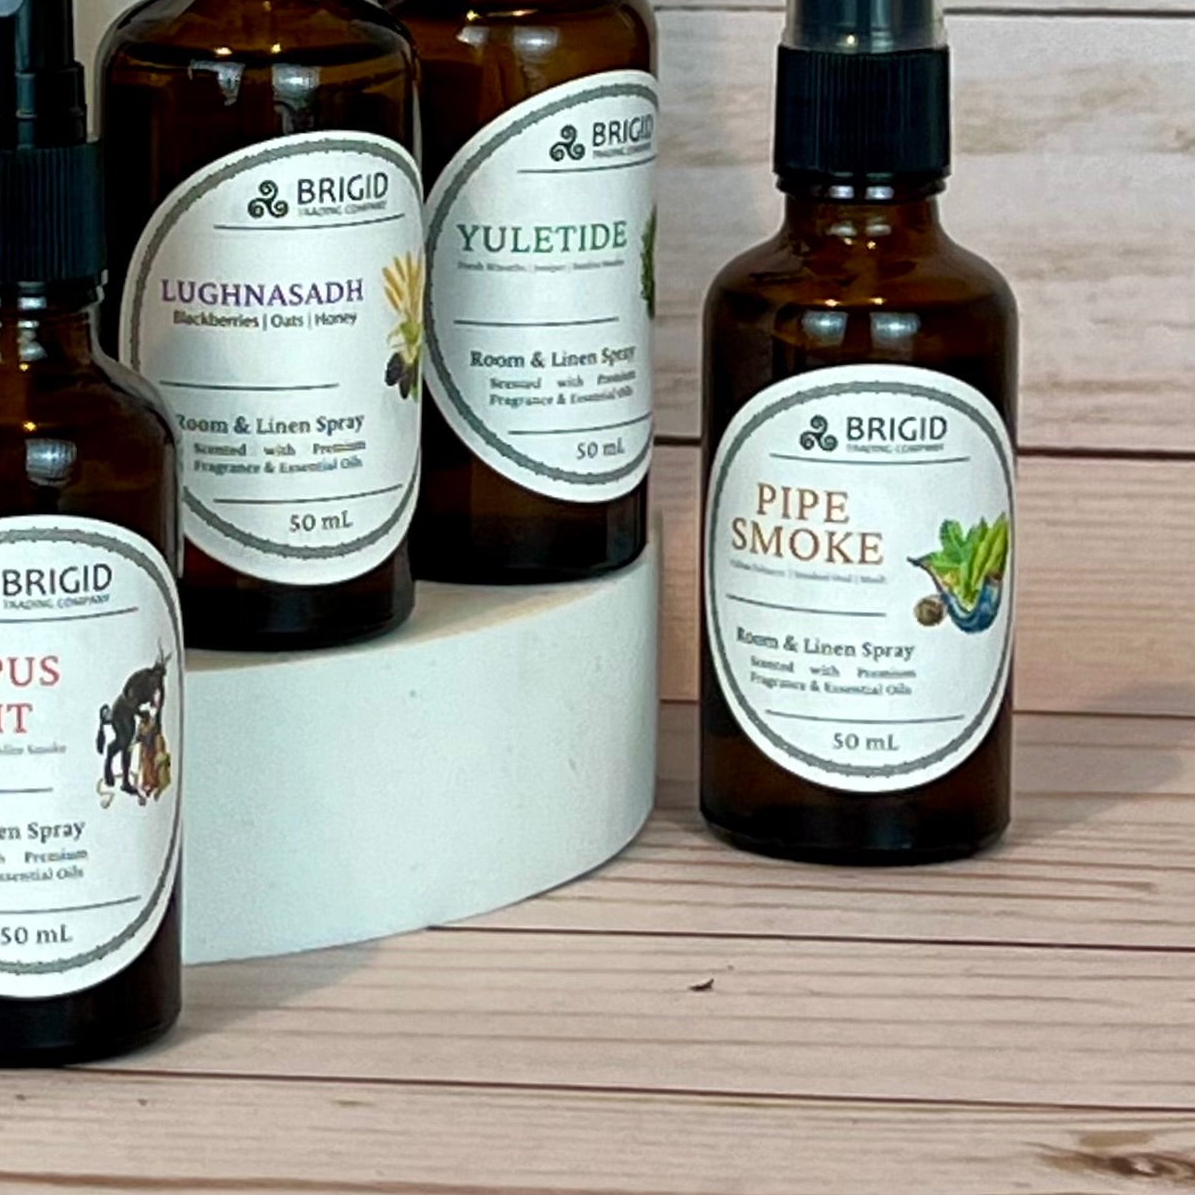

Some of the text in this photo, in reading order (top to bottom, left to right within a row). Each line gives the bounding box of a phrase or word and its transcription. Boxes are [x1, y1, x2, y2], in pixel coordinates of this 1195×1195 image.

[297, 172, 388, 203] BRIGID
[457, 220, 628, 253] YULETIDE
[161, 278, 364, 306] LUGHNASADH
[174, 311, 357, 329] Blackberries Oats Honey
[470, 351, 524, 367] Room
[530, 352, 544, 367] &
[552, 350, 597, 367] Linen
[234, 416, 251, 435] &
[256, 416, 311, 435] Linen
[316, 414, 365, 435] Spray
[846, 416, 947, 442] BRIGID
[264, 443, 296, 456] with
[577, 436, 625, 459] 50 mL
[264, 462, 275, 474] &
[757, 482, 850, 524] PIPE
[289, 510, 353, 532] 50 mL
[731, 518, 884, 566] SMOKE
[2, 563, 112, 596] BRIGID
[736, 626, 914, 661] Room & Linen Spray
[810, 664, 840, 678] with
[885, 683, 912, 696] Oils
[832, 732, 899, 751] 50 mL
[27, 820, 85, 843] Spray
[24, 848, 88, 863] Premium
[57, 867, 84, 880] Oils
[1, 924, 72, 945] 50 mL
